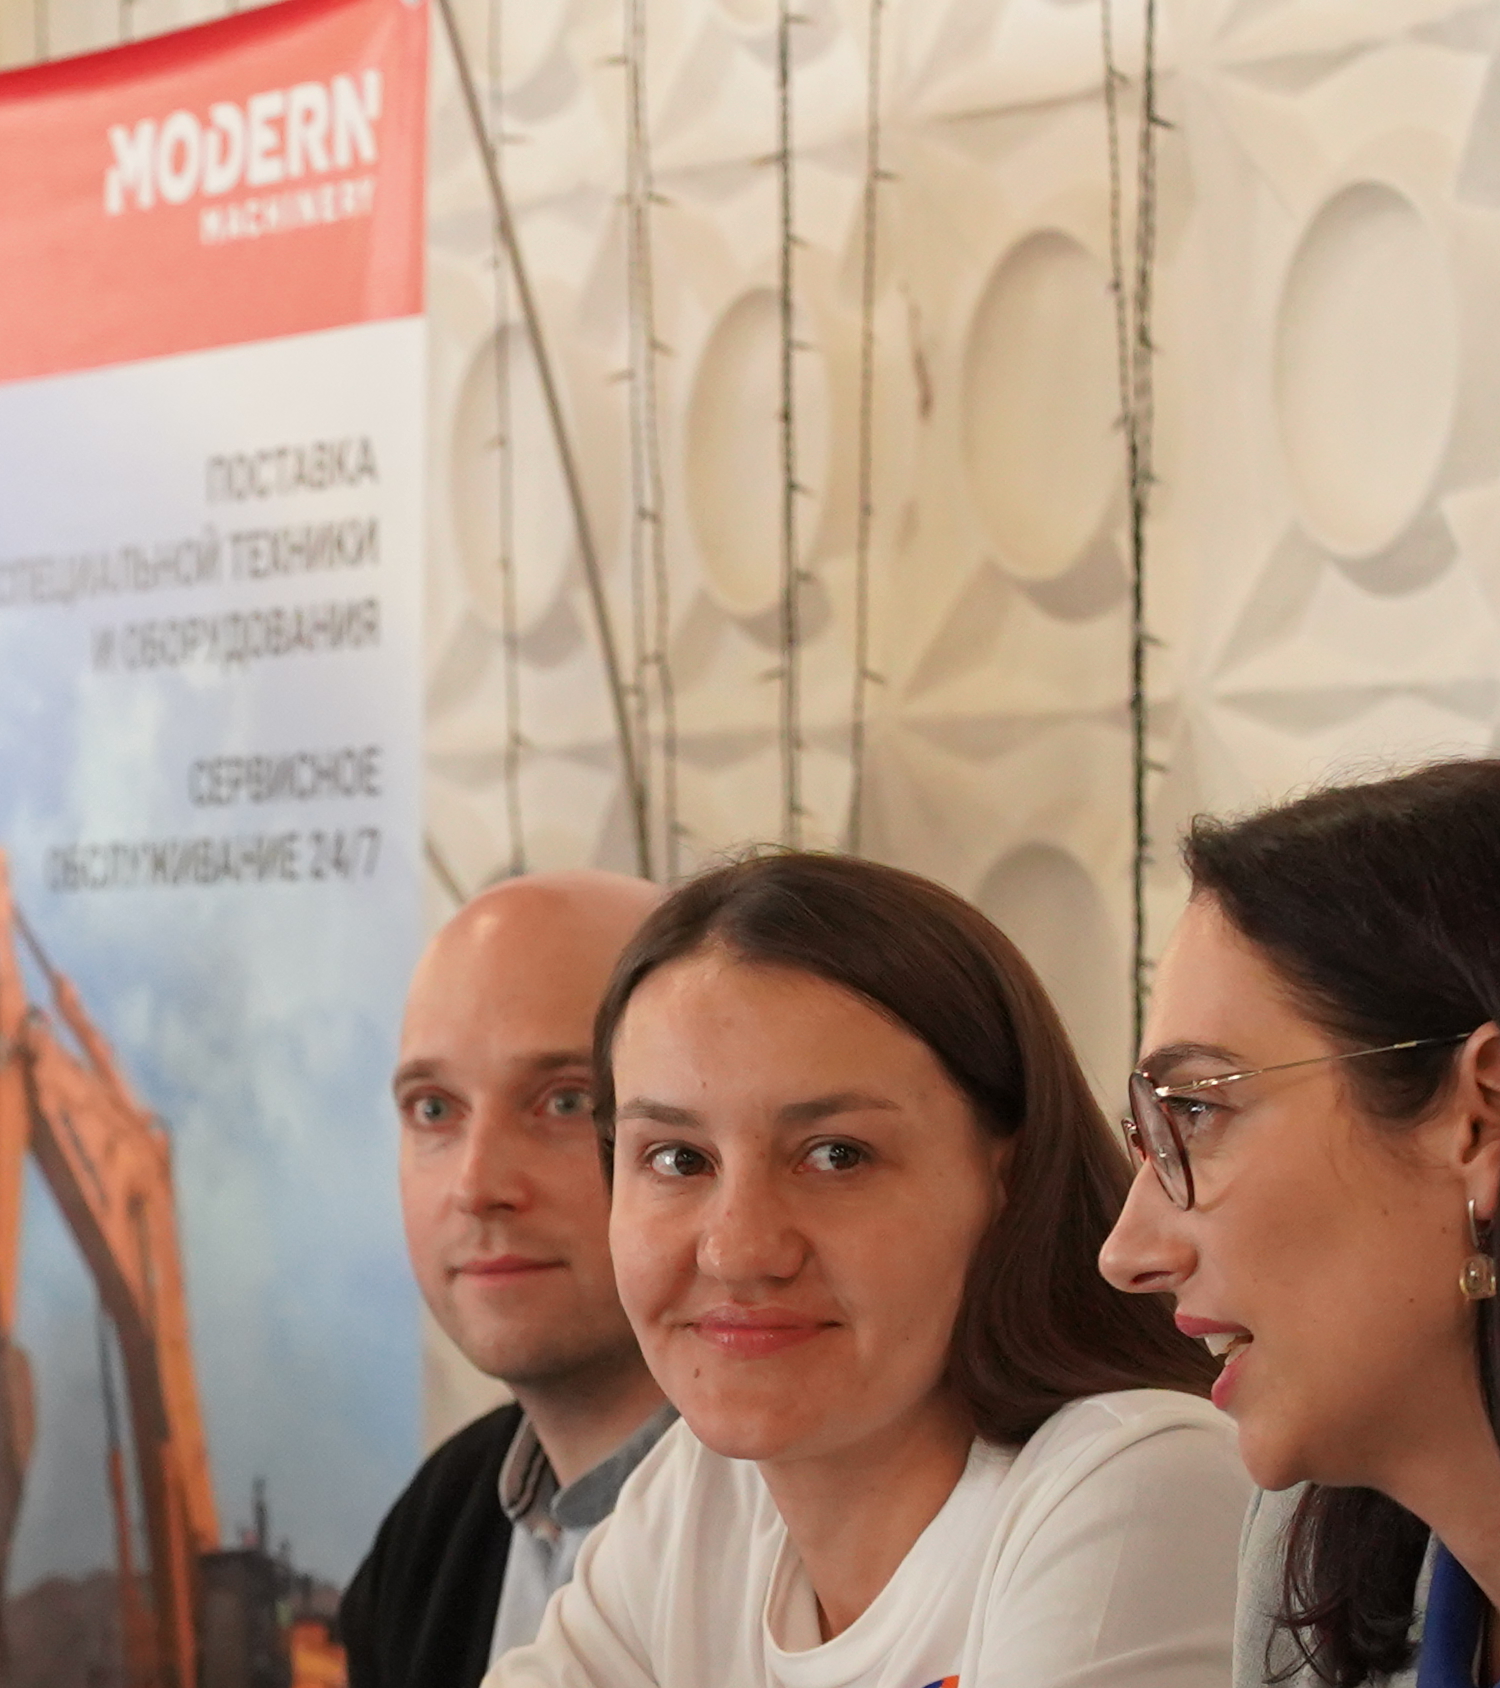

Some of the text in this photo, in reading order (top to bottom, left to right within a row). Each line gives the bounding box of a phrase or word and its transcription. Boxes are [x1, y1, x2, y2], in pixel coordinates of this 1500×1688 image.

[104, 66, 384, 217] MODERN
[199, 174, 375, 246] MACHINERY
[205, 436, 380, 502] ПОСТАВКА
[228, 517, 381, 581] ТЕХНИКИ
[121, 596, 382, 678] ОБОРУДОВАНИЯ
[189, 745, 382, 809] СЕРВИСНОЕ
[44, 826, 300, 893] ОБСЛУЖИВАНИЕ
